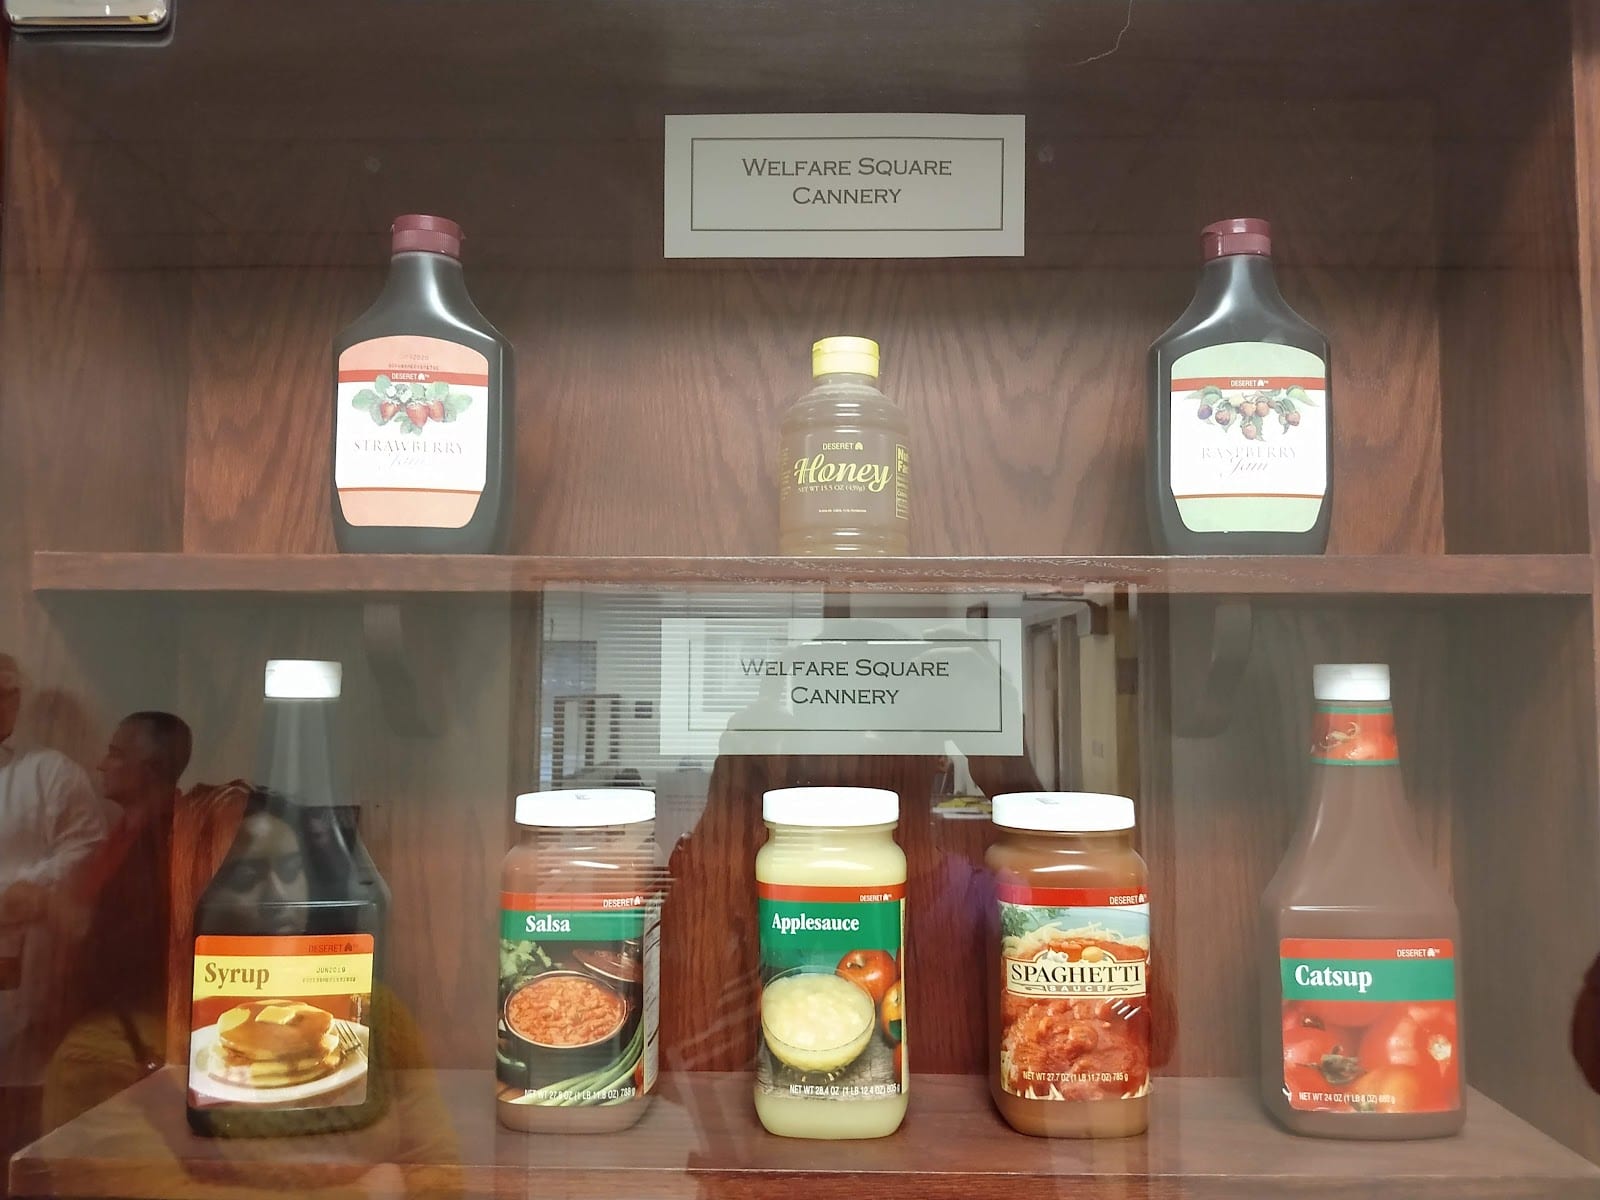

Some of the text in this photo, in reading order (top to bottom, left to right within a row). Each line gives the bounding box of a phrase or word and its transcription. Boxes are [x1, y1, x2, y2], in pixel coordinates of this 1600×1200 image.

[742, 157, 952, 177] WELFARE SQUARE
[792, 187, 902, 205] CANNERY
[391, 372, 417, 380] DESERET
[1231, 379, 1257, 387] DESERET
[353, 439, 464, 455] STRAWBERRY
[822, 442, 855, 451] DESERET
[1201, 447, 1297, 459] RASPBERRY
[1229, 456, 1269, 475] Jam
[794, 453, 894, 493] Honey
[740, 658, 950, 678] WELFARE SQUARE
[790, 686, 900, 705] CANNERY
[603, 897, 634, 908] DESERET
[860, 894, 884, 902] DESERET
[1110, 895, 1138, 905] DESERET
[525, 914, 571, 933] Salsa
[771, 912, 860, 935] Applesauce
[308, 943, 342, 953] DESERET
[1396, 948, 1427, 958] DESERET
[204, 962, 270, 990] Syrup
[1011, 963, 1140, 983] SPAGHETTI
[1294, 964, 1373, 994] Catsup
[1022, 1071, 1035, 1080] NET
[1036, 1072, 1046, 1081] WT
[1047, 1073, 1059, 1082] 27.7
[1061, 1073, 1069, 1082] OZ
[1078, 1073, 1087, 1082] LB
[1088, 1073, 1100, 1082] 11.7
[1101, 1073, 1112, 1082] OZ)
[563, 1091, 573, 1099] OZ
[582, 1091, 591, 1099] LB
[607, 1090, 619, 1099] OZ)
[789, 1084, 802, 1094] NET
[803, 1085, 814, 1094] WT
[815, 1085, 829, 1095] 28.4
[830, 1086, 839, 1096] OZ
[850, 1086, 859, 1095] LB
[874, 1085, 886, 1095] OZ)
[1298, 1092, 1310, 1101] NET
[1312, 1092, 1323, 1102] WT
[1324, 1093, 1332, 1102] 24
[1333, 1094, 1342, 1103] OZ
[1351, 1095, 1360, 1103] LB
[1366, 1094, 1378, 1104] OZ)
